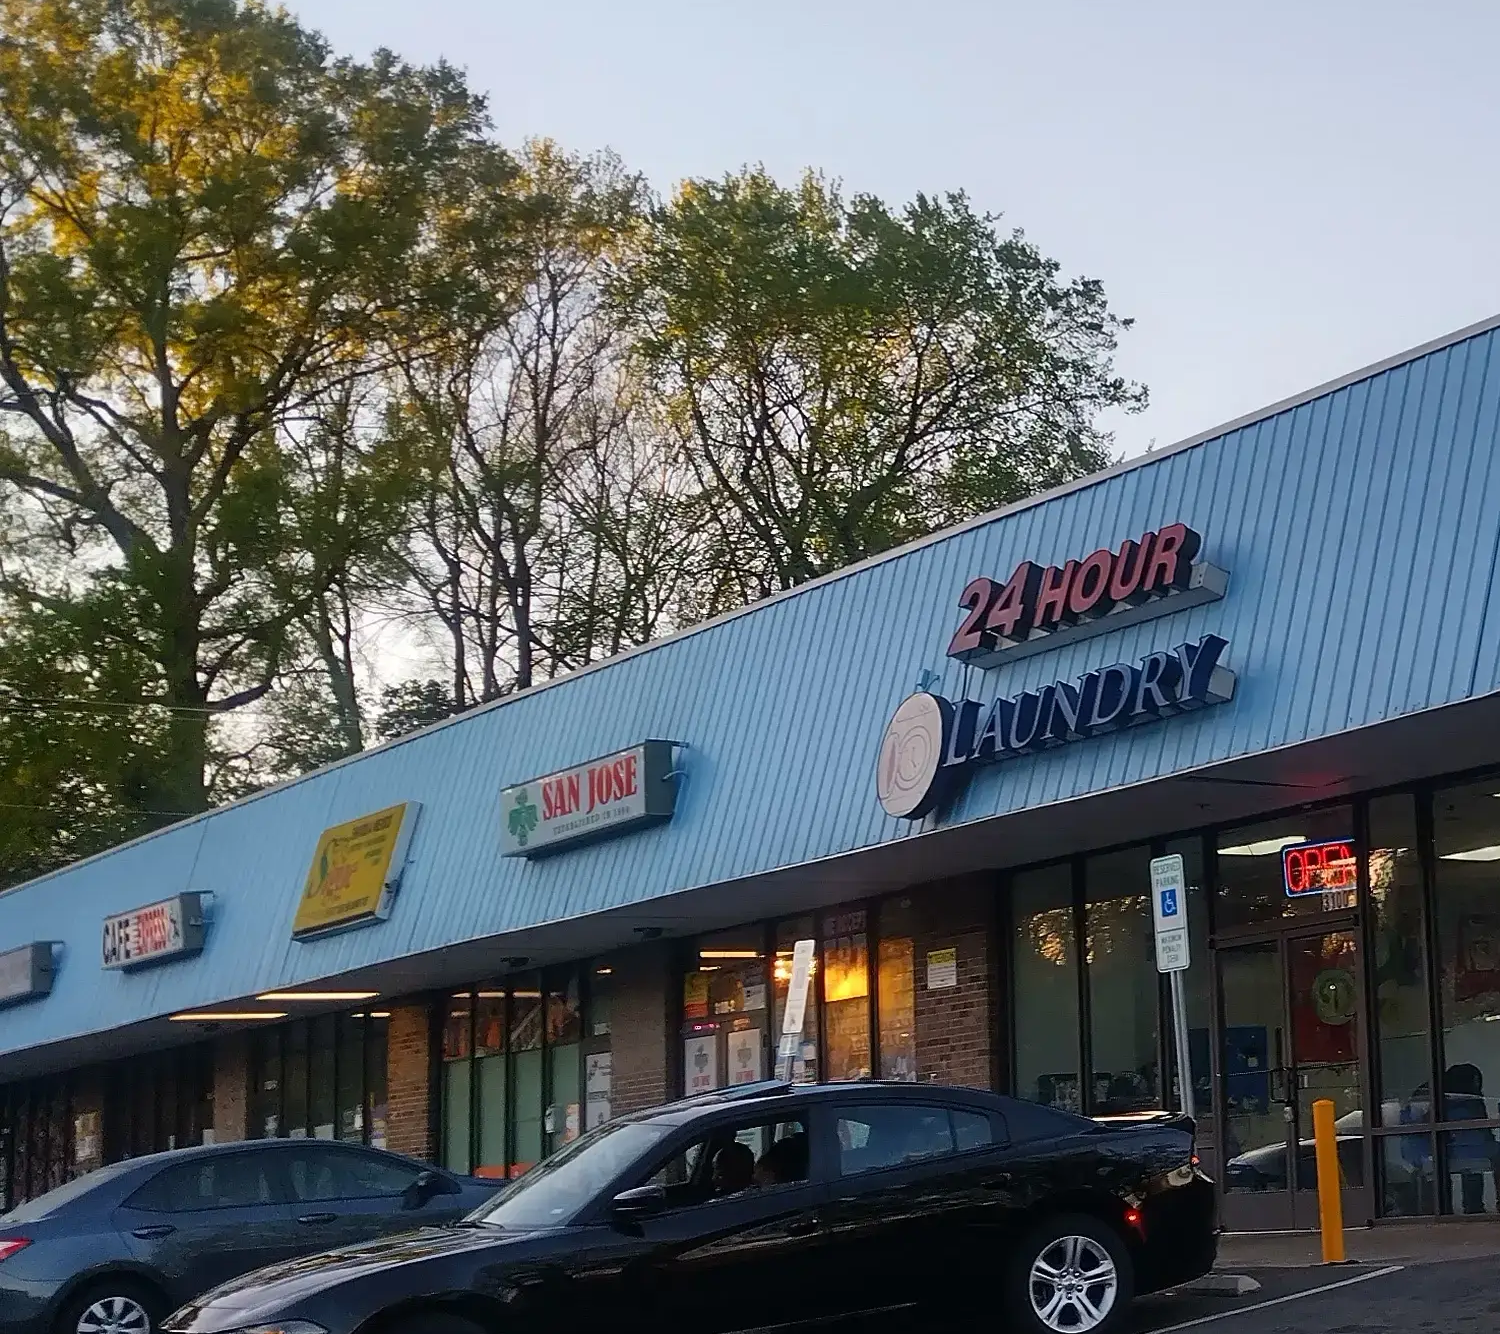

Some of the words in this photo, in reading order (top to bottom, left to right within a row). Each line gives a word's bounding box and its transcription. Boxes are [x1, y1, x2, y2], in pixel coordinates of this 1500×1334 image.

[947, 560, 1032, 657] 24
[1033, 522, 1190, 625] HOUR
[942, 633, 1226, 768] LAUNDRY
[541, 772, 581, 821] SAN
[584, 754, 638, 816] JOSE
[1287, 845, 1357, 892] OPEN
[102, 918, 131, 965] CAFE
